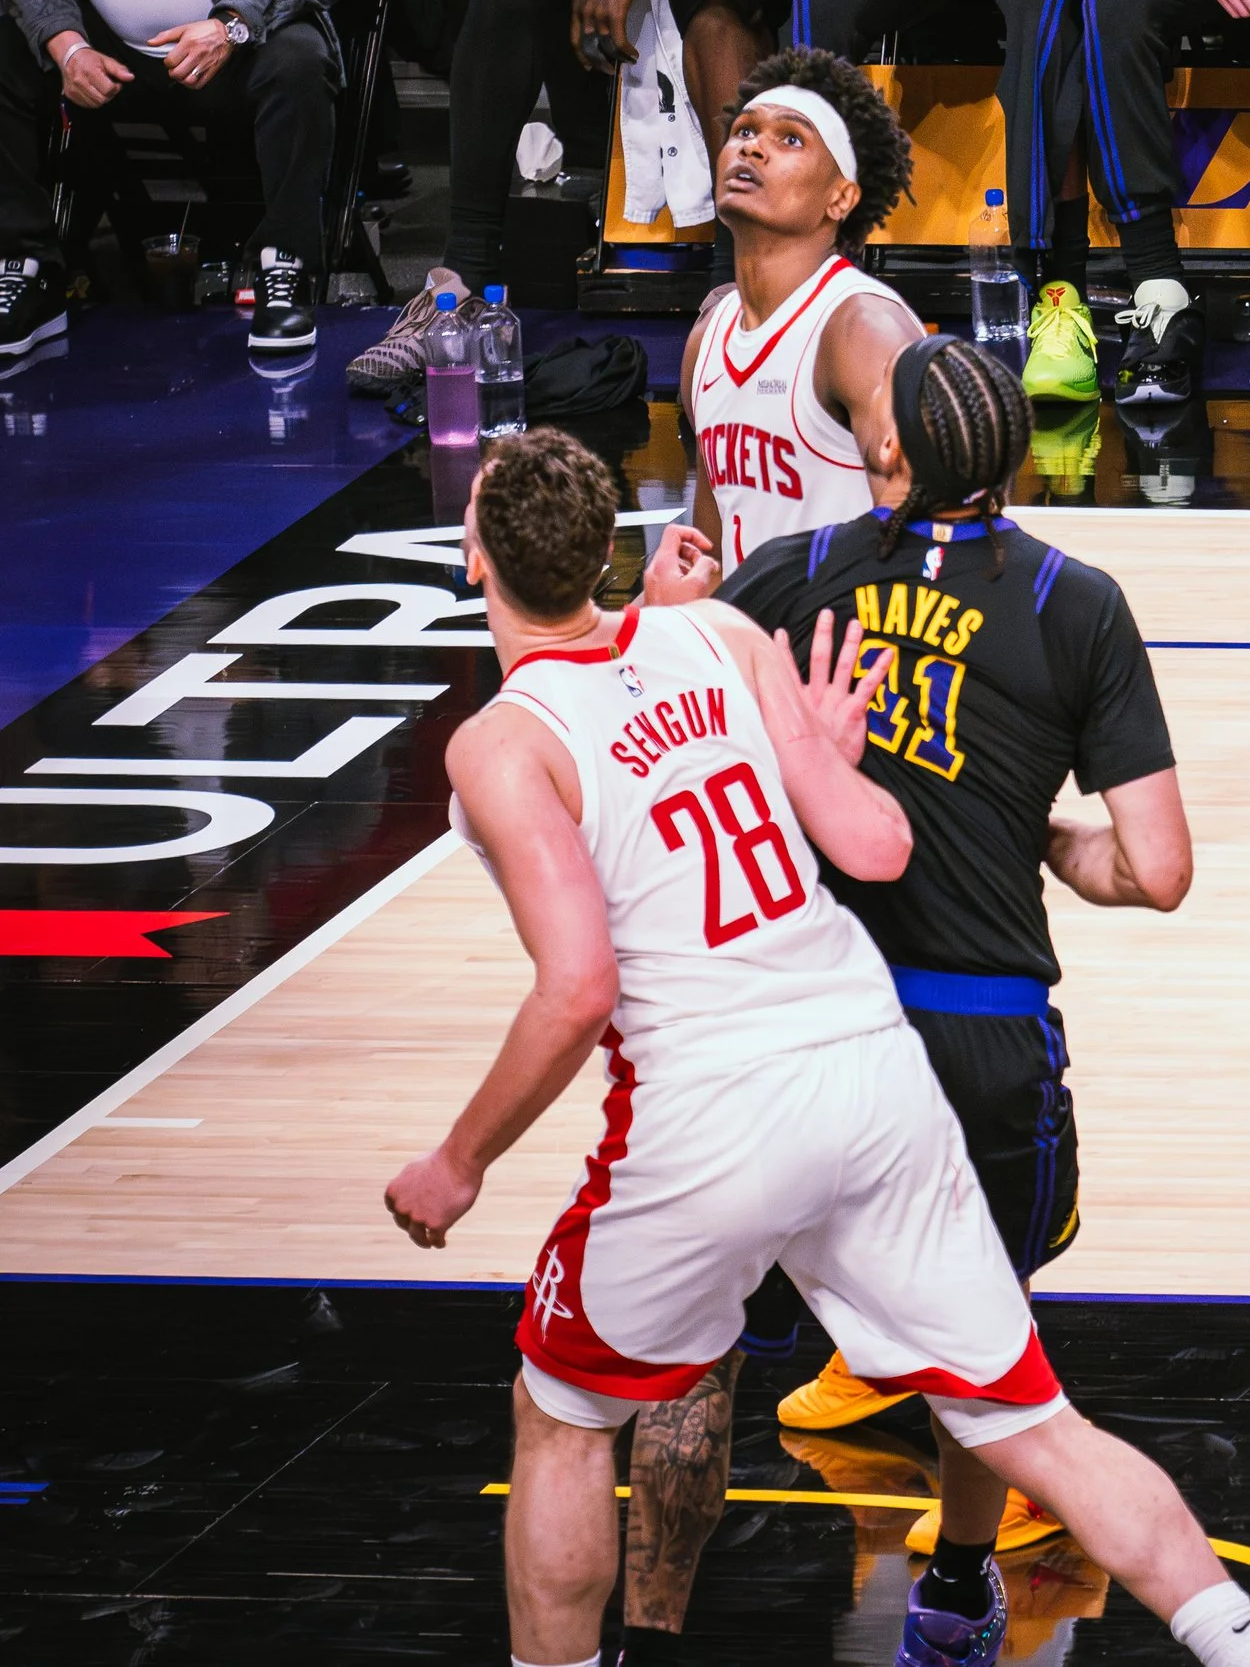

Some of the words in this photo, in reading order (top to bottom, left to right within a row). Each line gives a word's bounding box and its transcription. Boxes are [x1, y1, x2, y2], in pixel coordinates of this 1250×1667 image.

[699, 423, 804, 501] OCKETS
[855, 583, 984, 655] HAYES
[609, 687, 728, 778] SENGUN
[650, 761, 807, 949] 28
